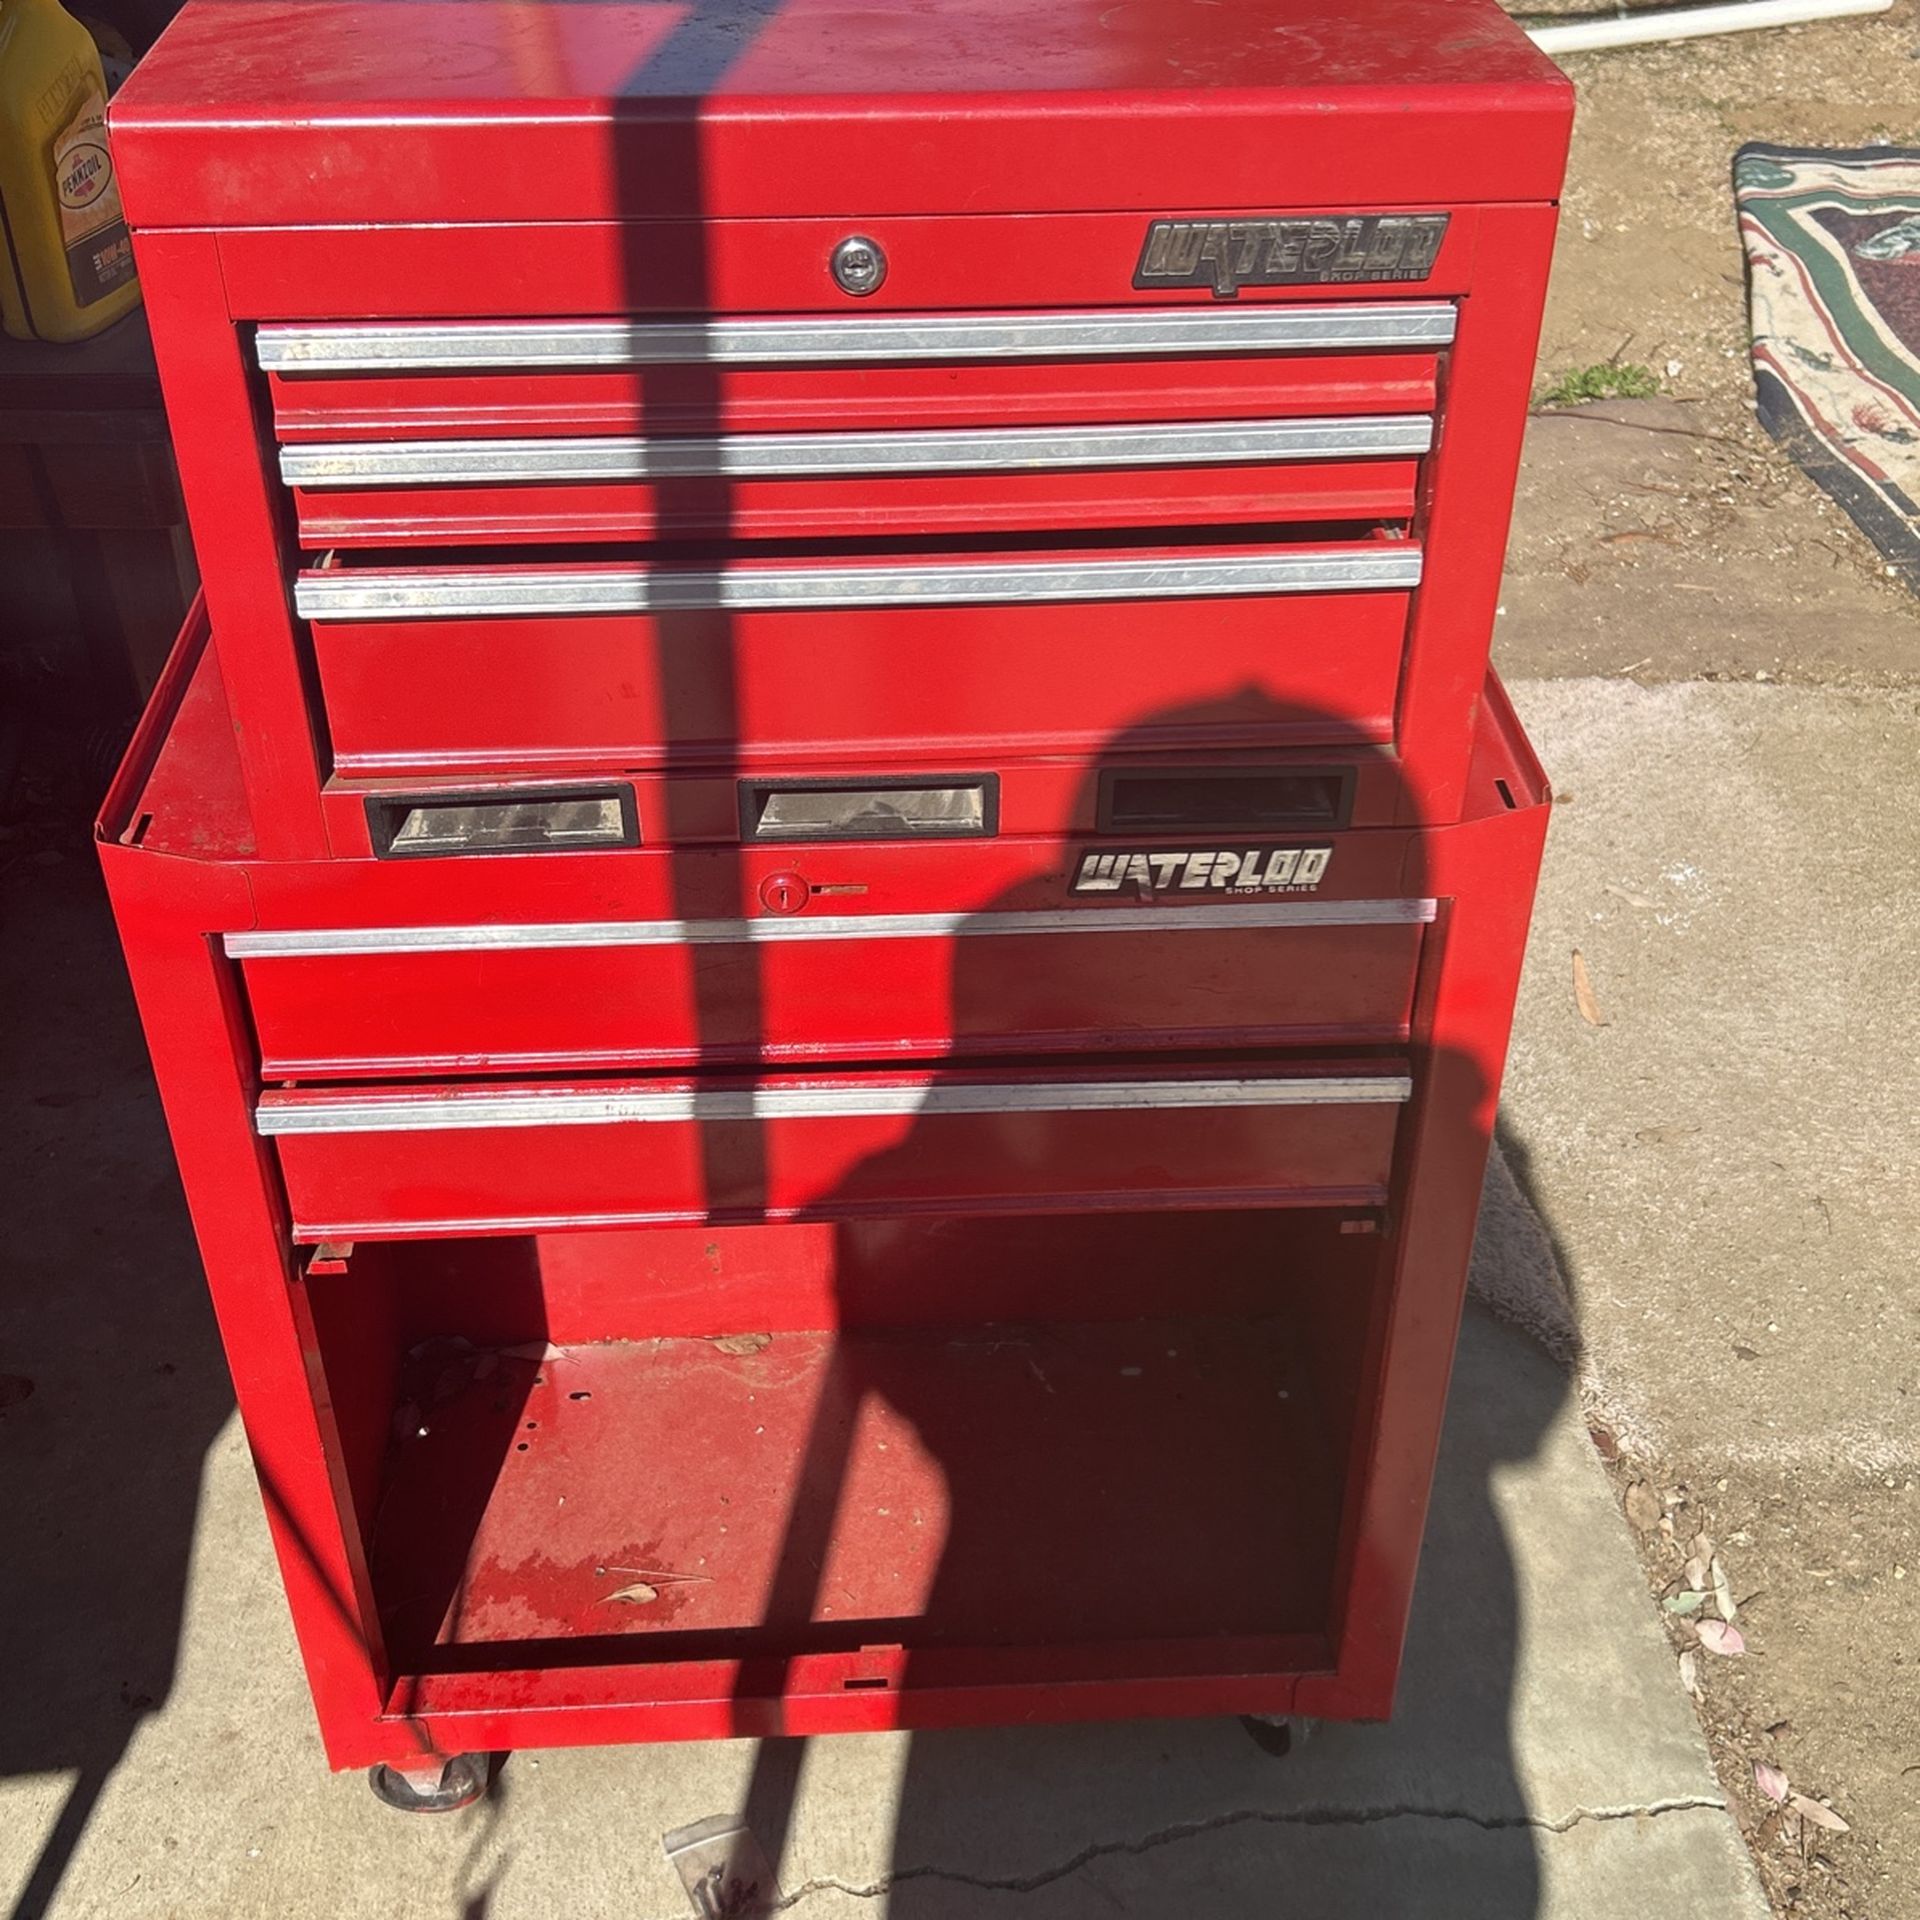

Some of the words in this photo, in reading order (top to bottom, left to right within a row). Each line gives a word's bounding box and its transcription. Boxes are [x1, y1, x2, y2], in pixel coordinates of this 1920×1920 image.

[1142, 217, 1447, 292] WATERLOO
[1319, 271, 1361, 282] SHOP
[1371, 269, 1430, 280] SERIES
[1075, 848, 1332, 900] WATERLOO
[1225, 885, 1263, 895] SHOP
[1268, 883, 1318, 893] SERIES
